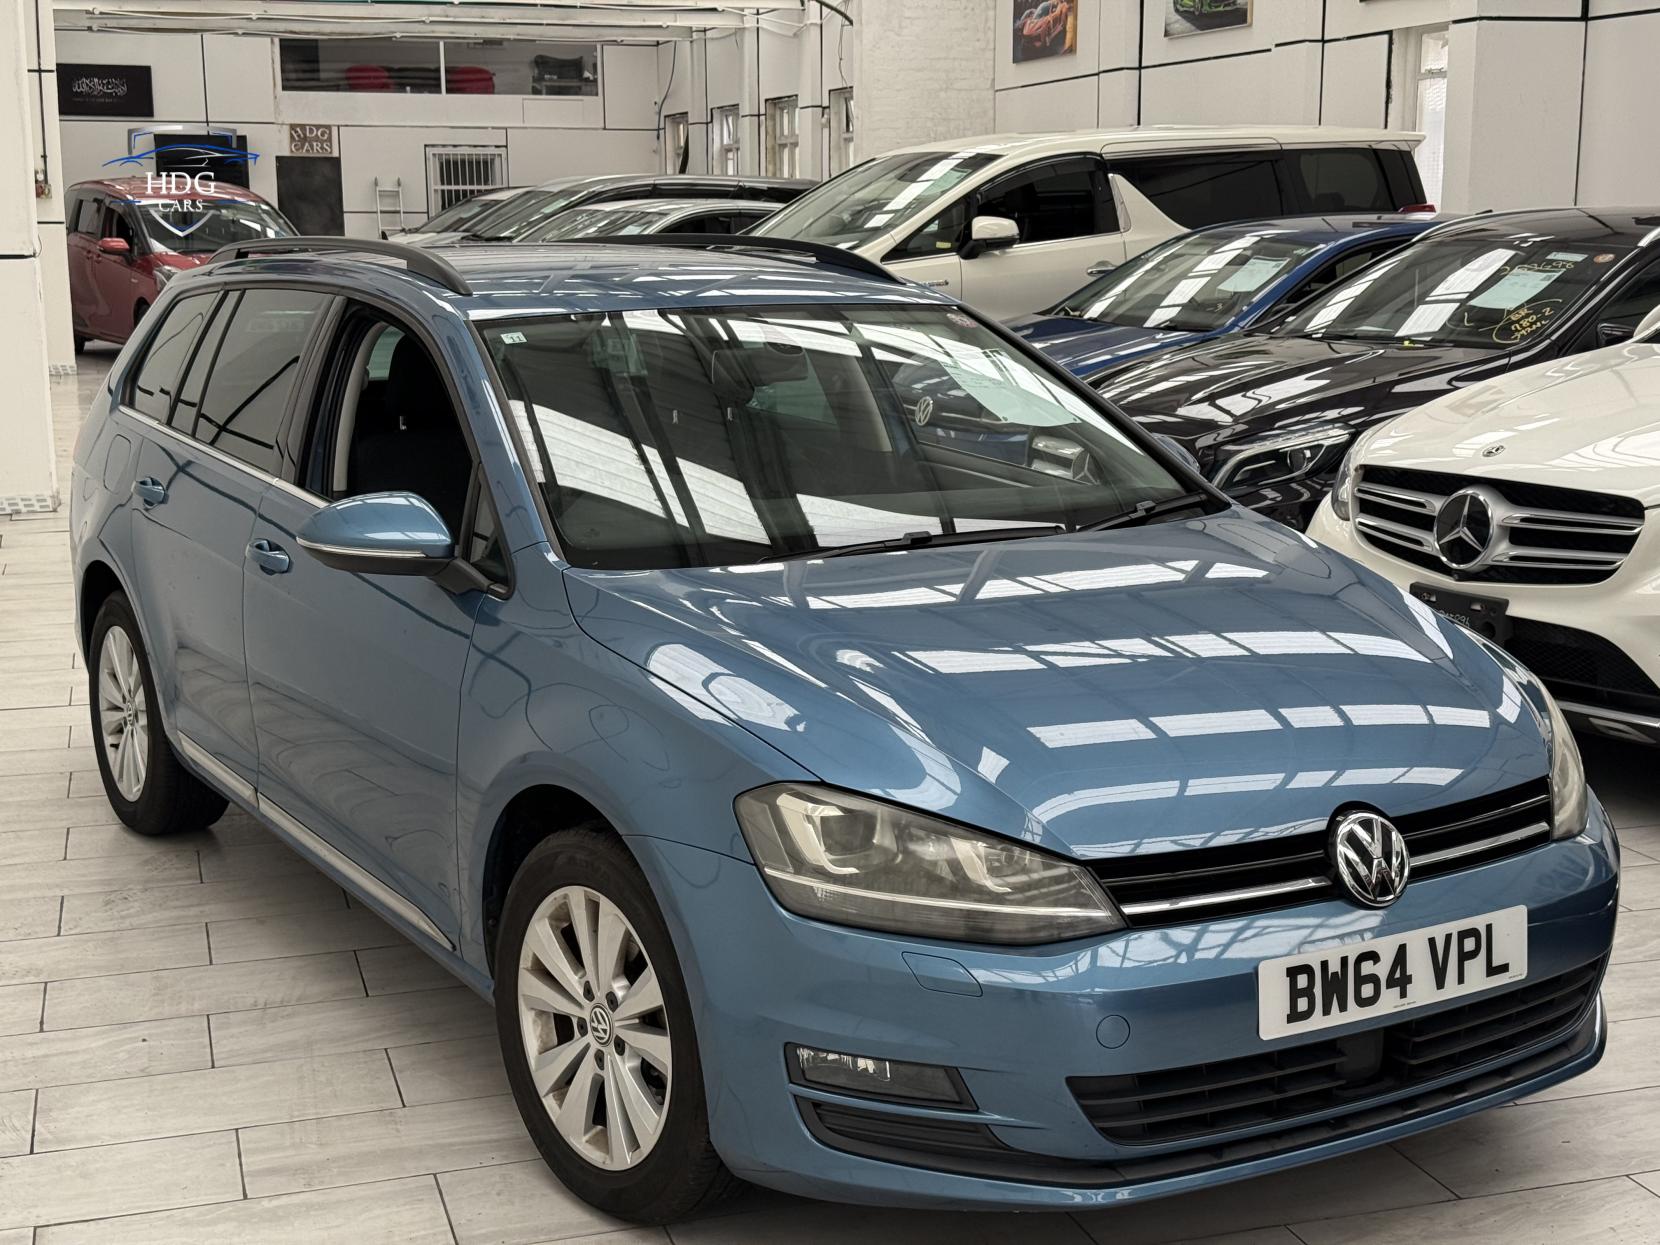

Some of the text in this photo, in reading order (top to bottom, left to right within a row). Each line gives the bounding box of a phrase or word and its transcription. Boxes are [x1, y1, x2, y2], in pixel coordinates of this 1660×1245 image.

[291, 126, 329, 140] HDG
[291, 142, 331, 153] CARS
[1286, 922, 1510, 1025] BW64 VPL
